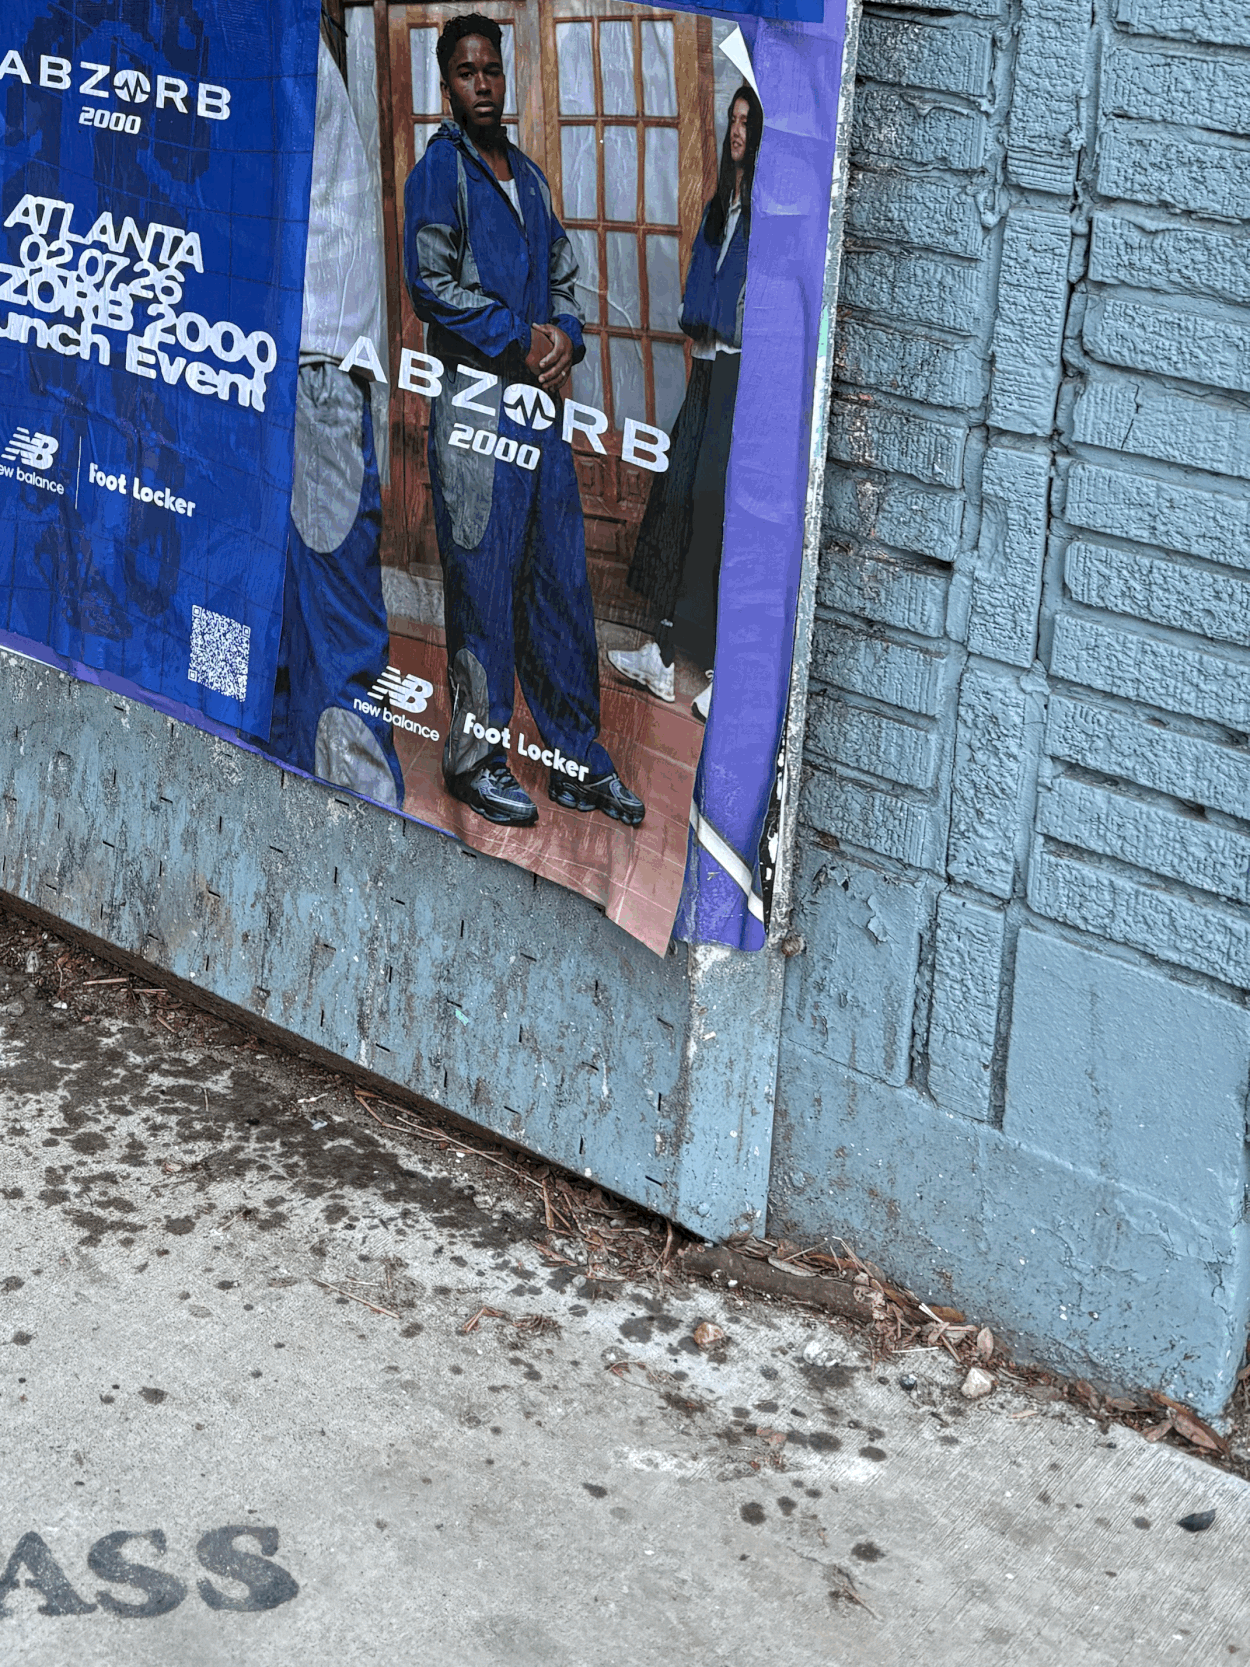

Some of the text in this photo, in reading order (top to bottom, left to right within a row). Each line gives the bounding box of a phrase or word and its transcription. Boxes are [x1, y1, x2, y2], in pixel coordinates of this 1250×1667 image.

[78, 106, 141, 135] 2000
[4, 194, 204, 273] ATLANTA
[146, 303, 277, 373] 2000
[125, 333, 265, 412] Event
[338, 335, 672, 474] ABZORB
[448, 422, 541, 472] 2000
[14, 464, 65, 495] balance
[89, 462, 196, 517] Foot Locker
[353, 697, 440, 742] new balance
[463, 711, 590, 783] Foot Locker
